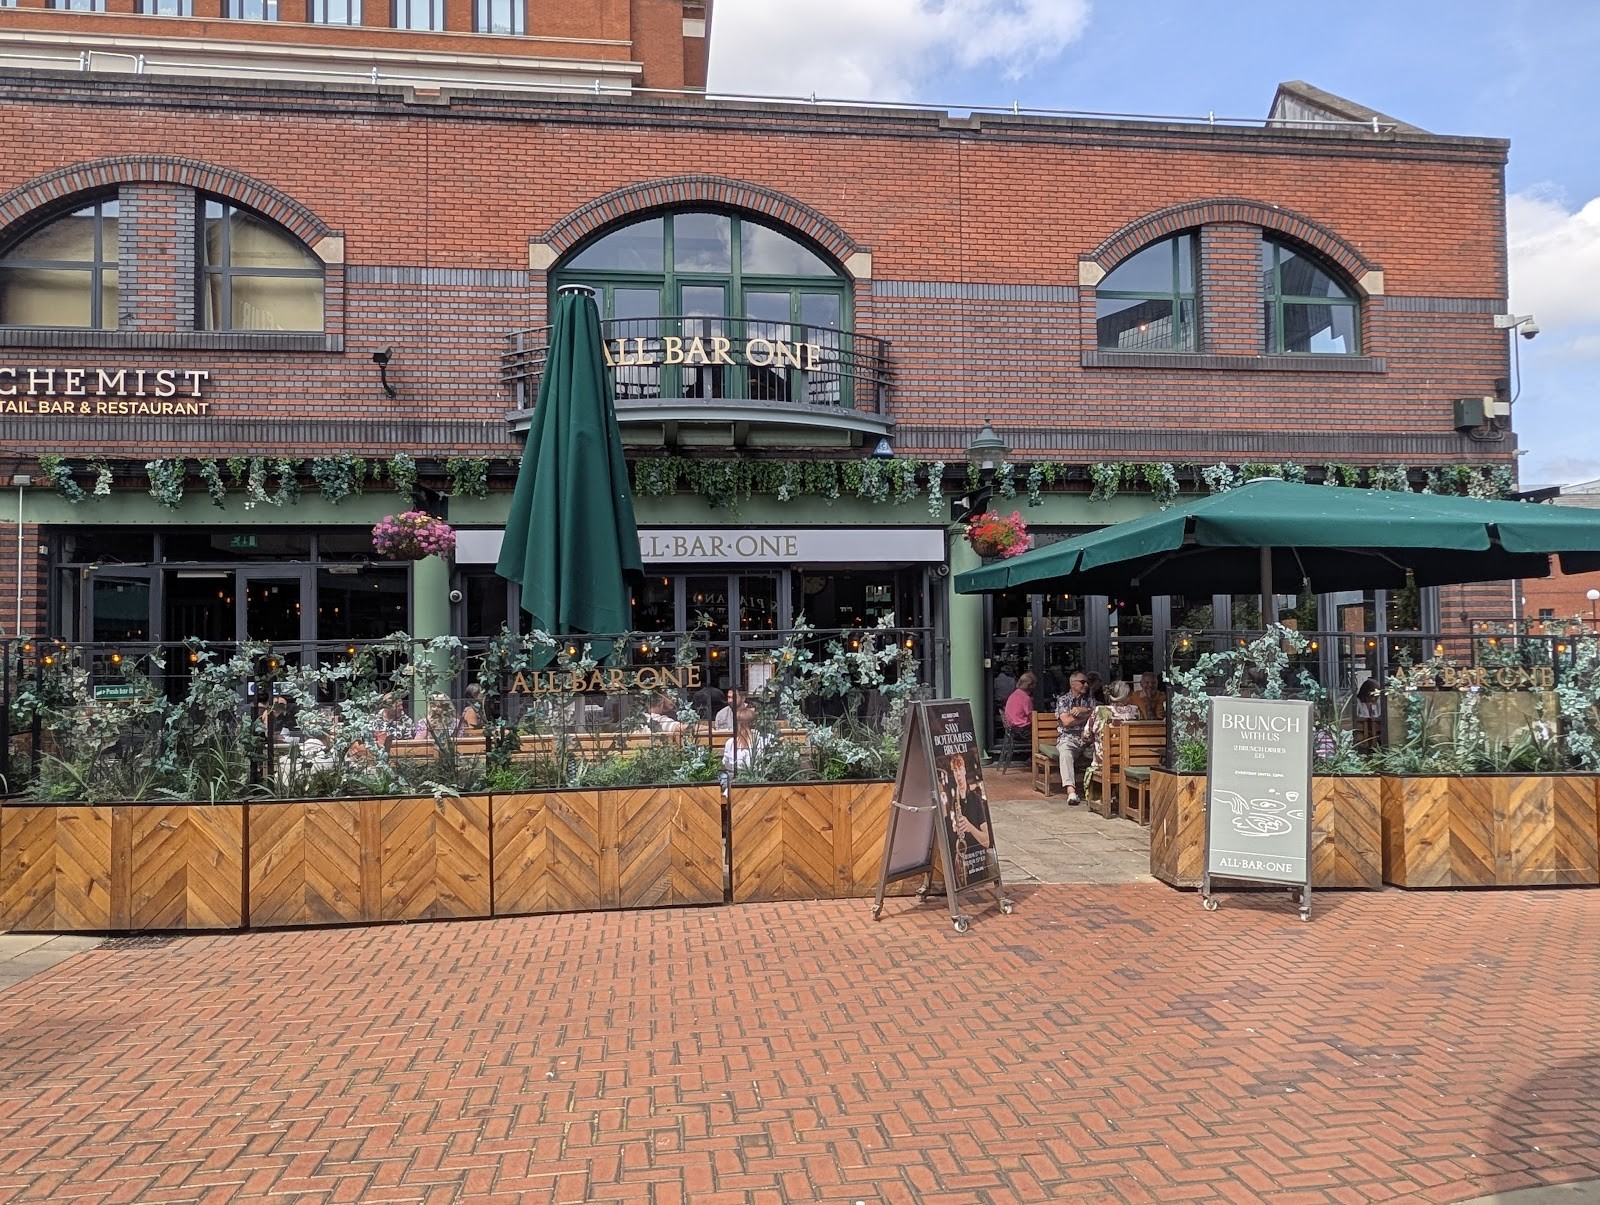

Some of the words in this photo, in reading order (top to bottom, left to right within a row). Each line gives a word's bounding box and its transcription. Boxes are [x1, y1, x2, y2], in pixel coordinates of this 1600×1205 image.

[662, 336, 737, 366] BAR
[745, 338, 823, 372] ONE
[0, 367, 209, 397] CHEMIST
[38, 401, 75, 414] BAR
[79, 401, 91, 414] &
[96, 402, 210, 415] RESTAURANT
[672, 535, 729, 557] BAR
[735, 535, 799, 557] ONE
[509, 671, 562, 694] ALL
[570, 668, 628, 692] BAR
[635, 665, 701, 690] ONE
[1442, 666, 1491, 687] BAR
[1222, 713, 1300, 733] BRUNCH
[934, 731, 973, 746] BOTTOMLESS
[1240, 730, 1266, 741] WITH
[1267, 732, 1280, 742] US
[943, 742, 968, 756] BRUNCH
[1264, 746, 1287, 754] DISHES
[1220, 857, 1239, 868] ALL
[1242, 859, 1264, 870] BAR
[1266, 861, 1293, 873] ONE
